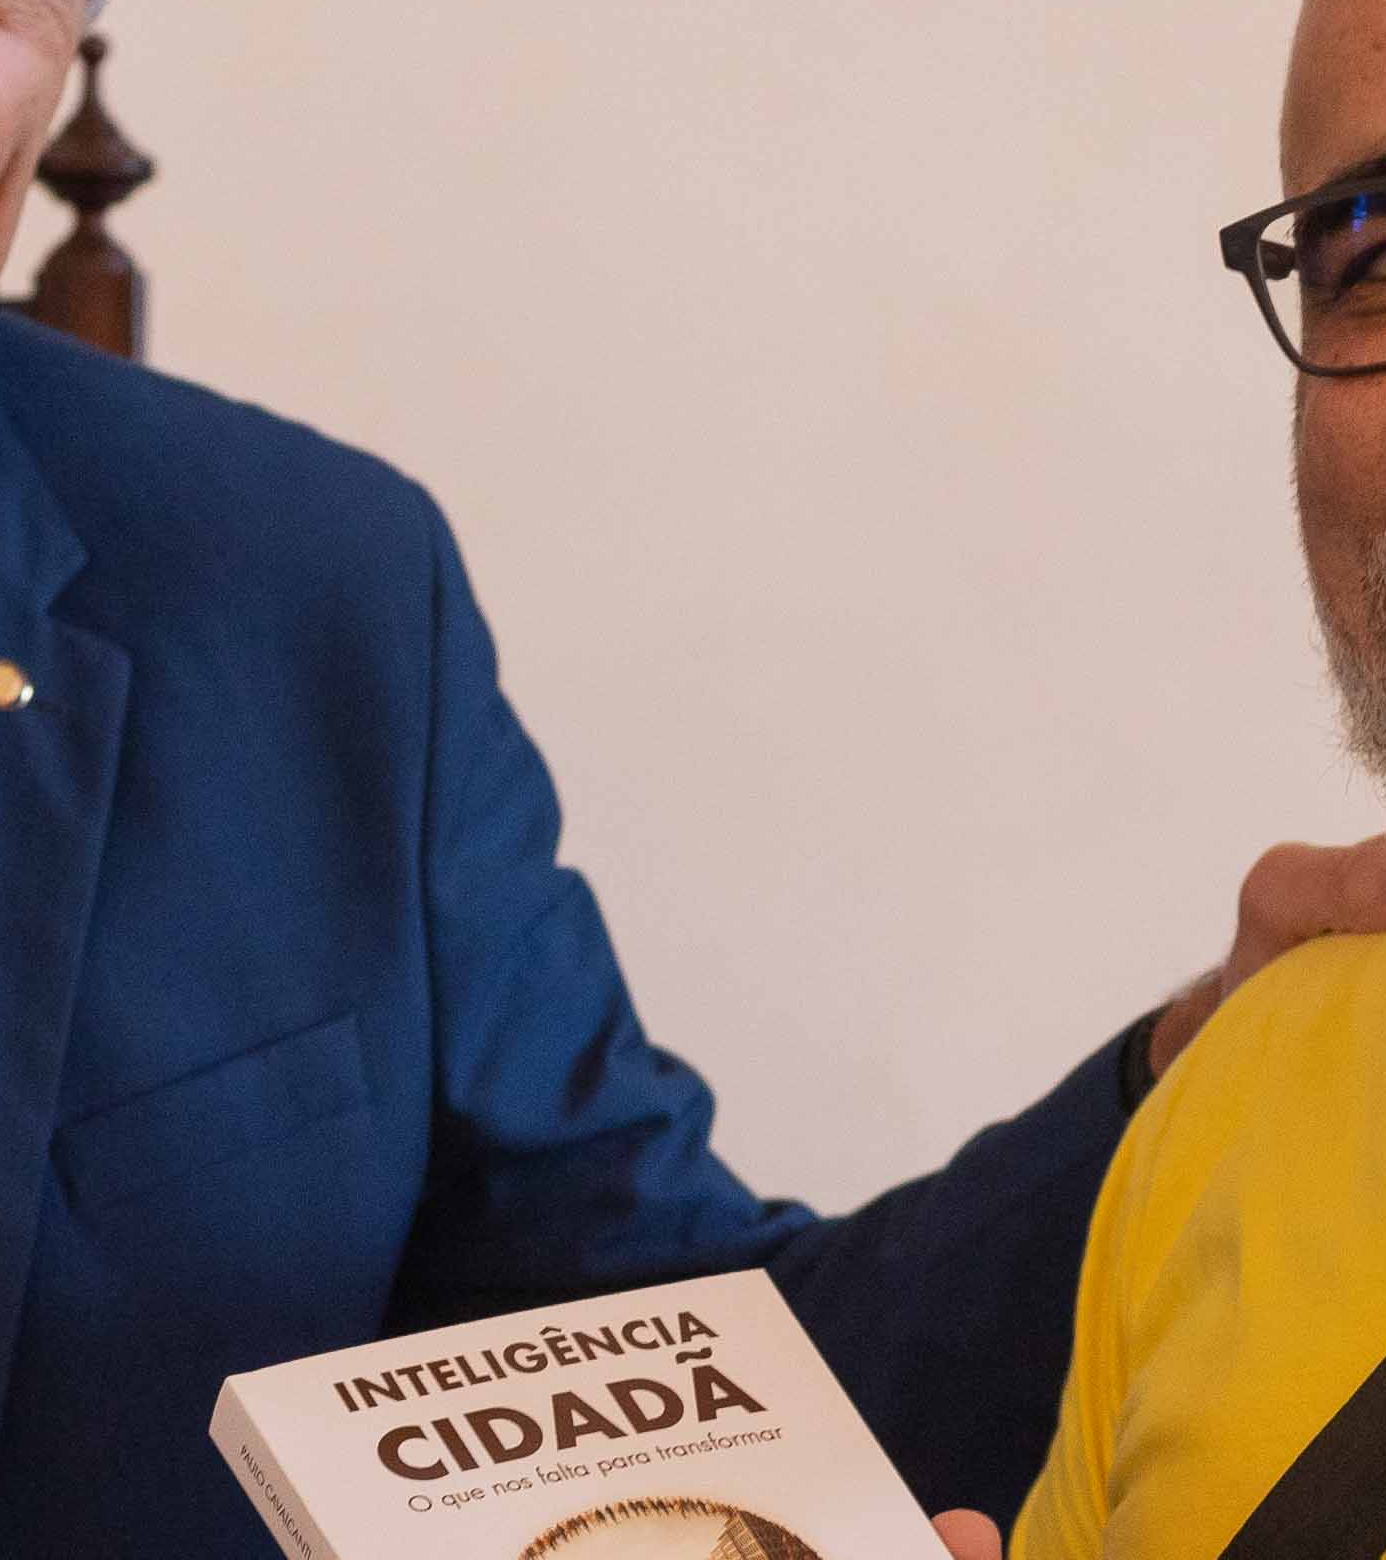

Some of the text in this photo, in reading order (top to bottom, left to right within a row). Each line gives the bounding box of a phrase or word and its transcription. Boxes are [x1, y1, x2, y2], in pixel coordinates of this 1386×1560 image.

[333, 1311, 719, 1413] INTELIGÊNCIA
[376, 1346, 768, 1482] CIDADÃ
[239, 1444, 265, 1486] PAULO
[408, 1425, 783, 1513] O que nos falta para transformar
